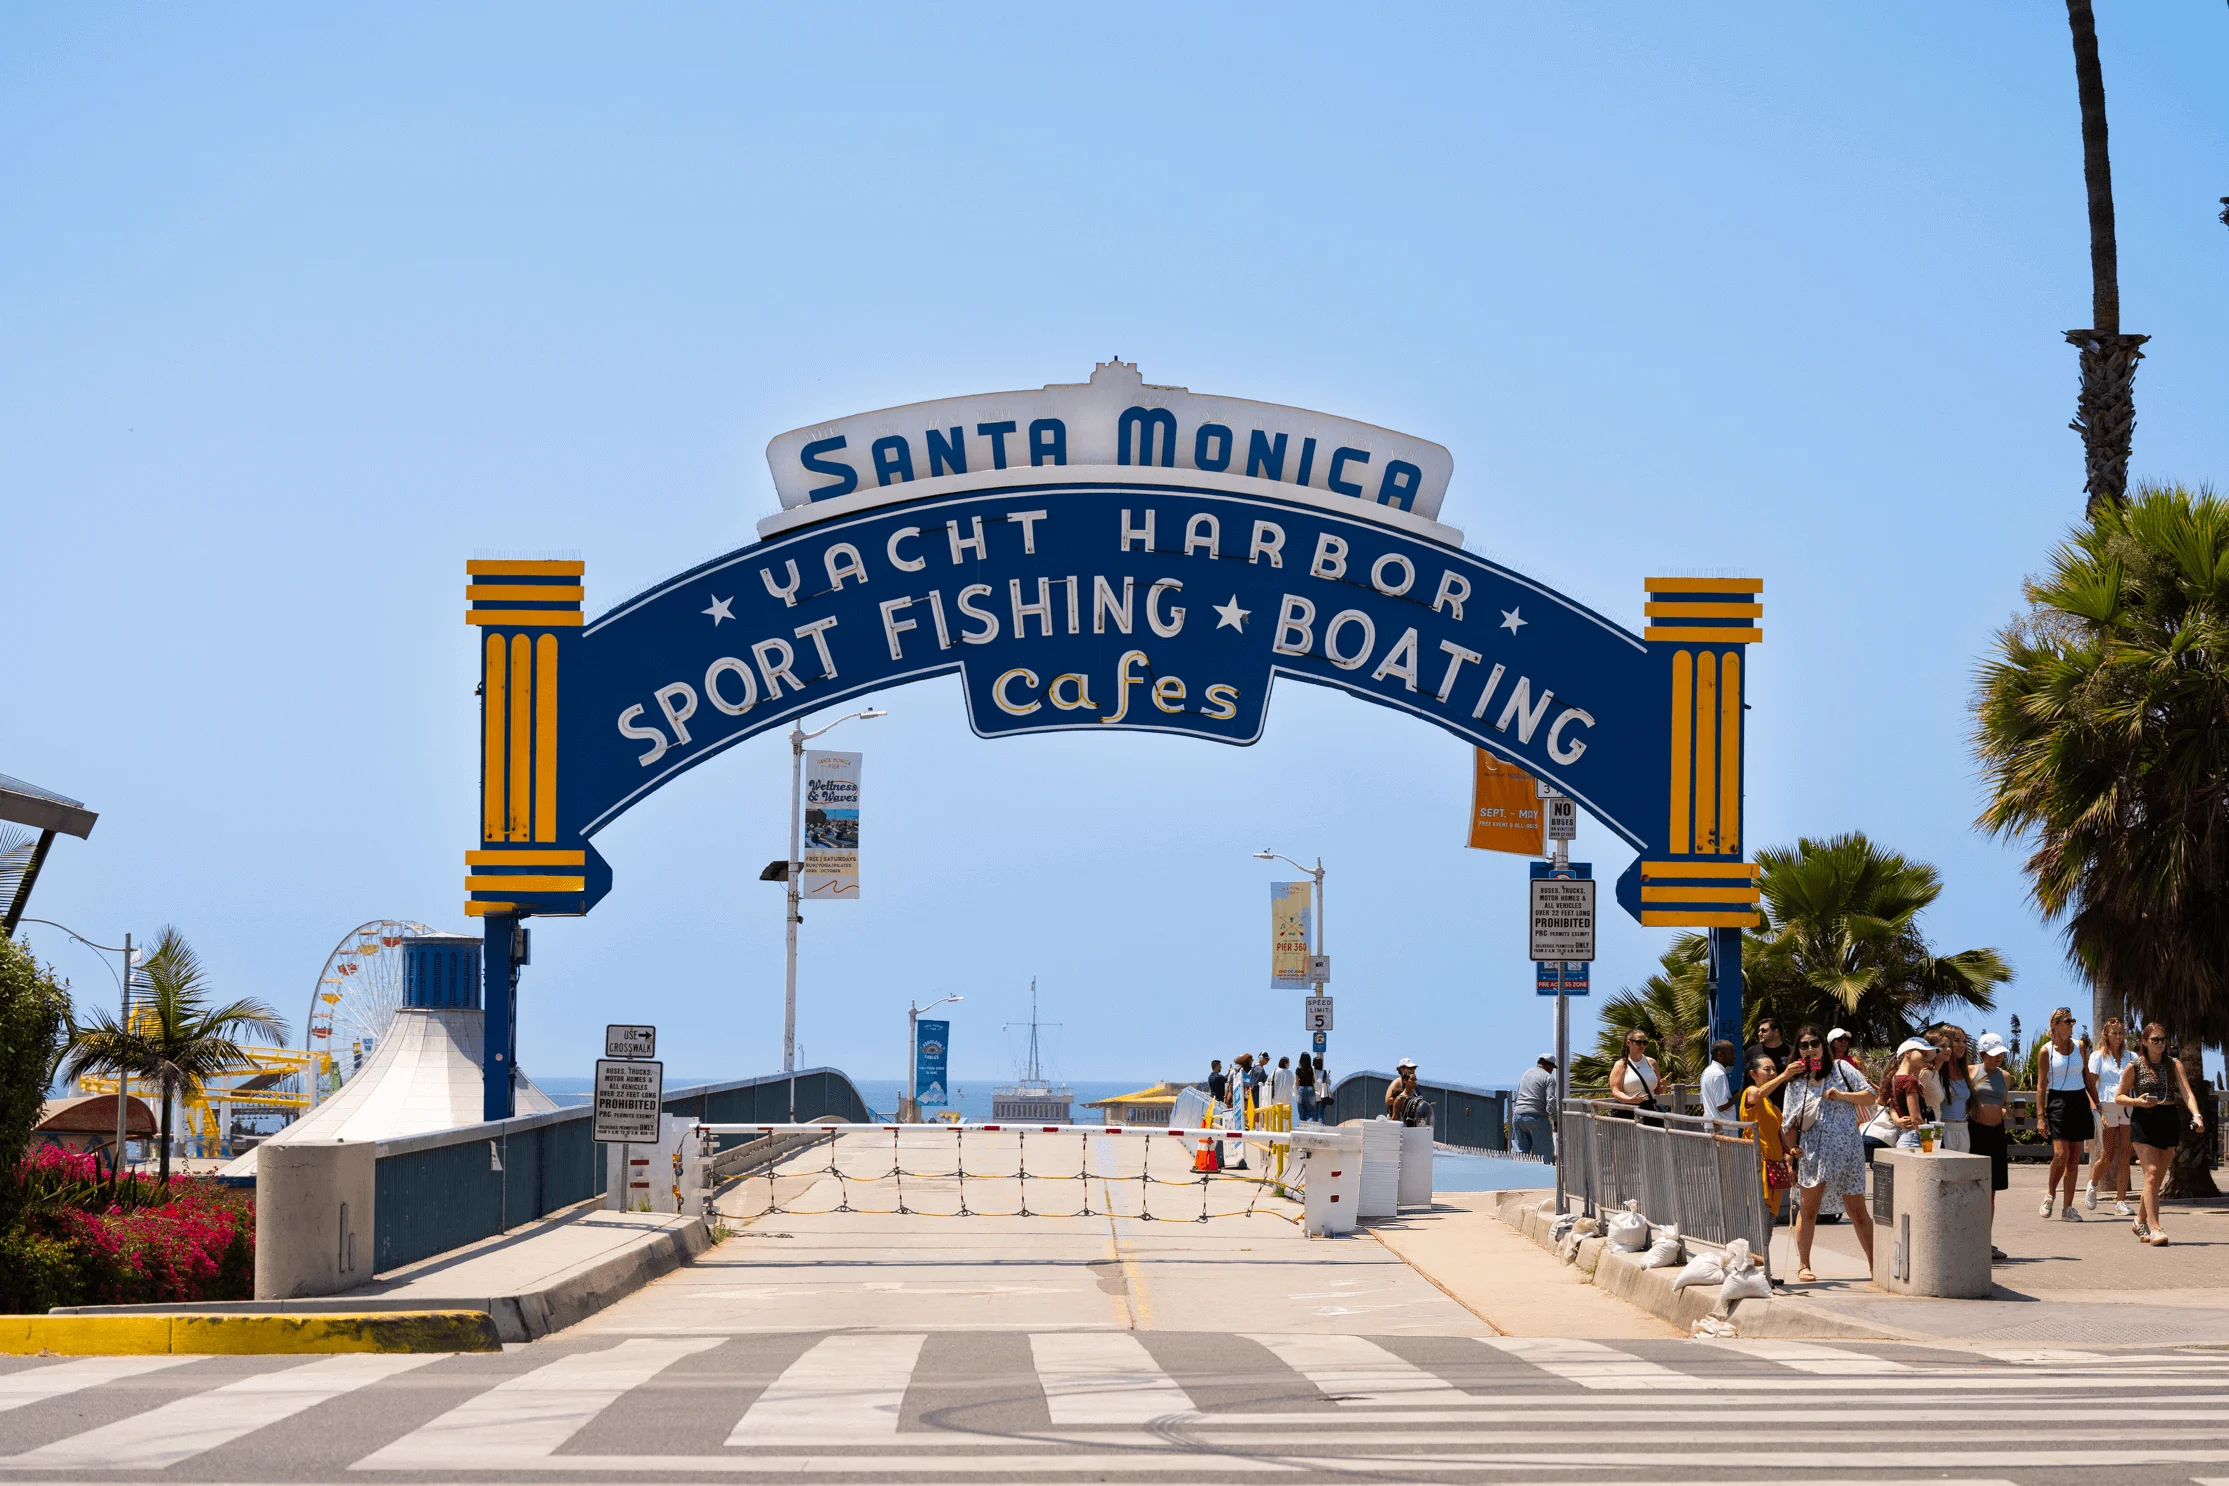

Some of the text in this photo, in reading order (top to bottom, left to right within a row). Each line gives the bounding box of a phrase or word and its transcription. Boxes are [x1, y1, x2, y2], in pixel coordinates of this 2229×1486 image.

[800, 406, 1422, 512] SANTA MONICA
[760, 509, 1471, 621] YACHT HARBOR
[618, 575, 1595, 767] SPORT FISHING BOATING
[808, 779, 857, 791] Wellness
[1543, 785, 1551, 794] 3
[808, 790, 858, 802] & Waves
[1480, 808, 1507, 818] SEPT.
[1519, 810, 1539, 819] MAY
[1555, 803, 1571, 816] NO
[1541, 887, 1586, 895] BUSES, TRUCKS,
[1535, 918, 1591, 928] PROHIBITED
[1276, 943, 1307, 951] PIER 360
[1315, 1015, 1324, 1028] 5
[624, 1030, 638, 1040] USE
[610, 1042, 651, 1053] CROSSWALK
[629, 1068, 652, 1076] TRUCKS,
[600, 1099, 656, 1110] PROHIBITED
